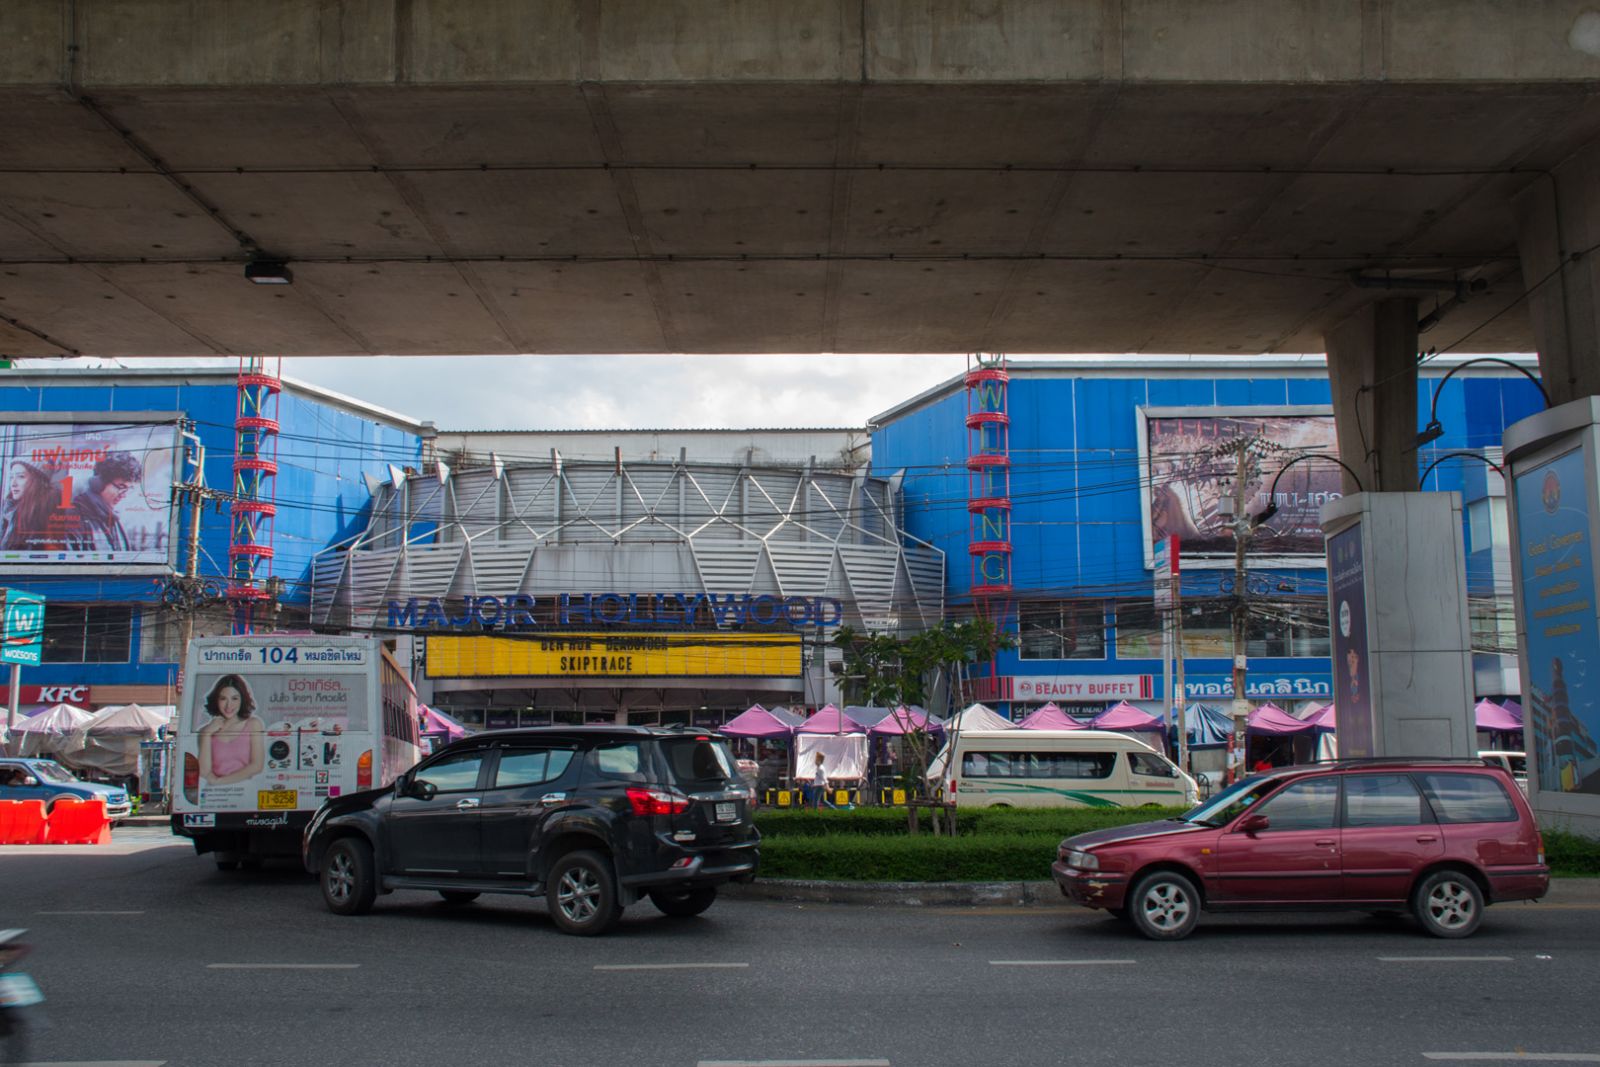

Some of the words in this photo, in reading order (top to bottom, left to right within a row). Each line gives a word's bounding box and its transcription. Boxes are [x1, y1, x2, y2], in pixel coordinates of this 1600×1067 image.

[56, 475, 76, 509] 1
[386, 593, 537, 627] MAJOR
[558, 592, 845, 627] HOLLYWOOD
[4, 649, 38, 661] watsons
[204, 649, 252, 661] ปากเกร็ด
[259, 647, 299, 664] 104
[560, 656, 633, 671] SKIPTRACE
[37, 685, 86, 702] KFC
[1035, 683, 1082, 695] BEAUTY
[1088, 683, 1134, 694] BUFFET
